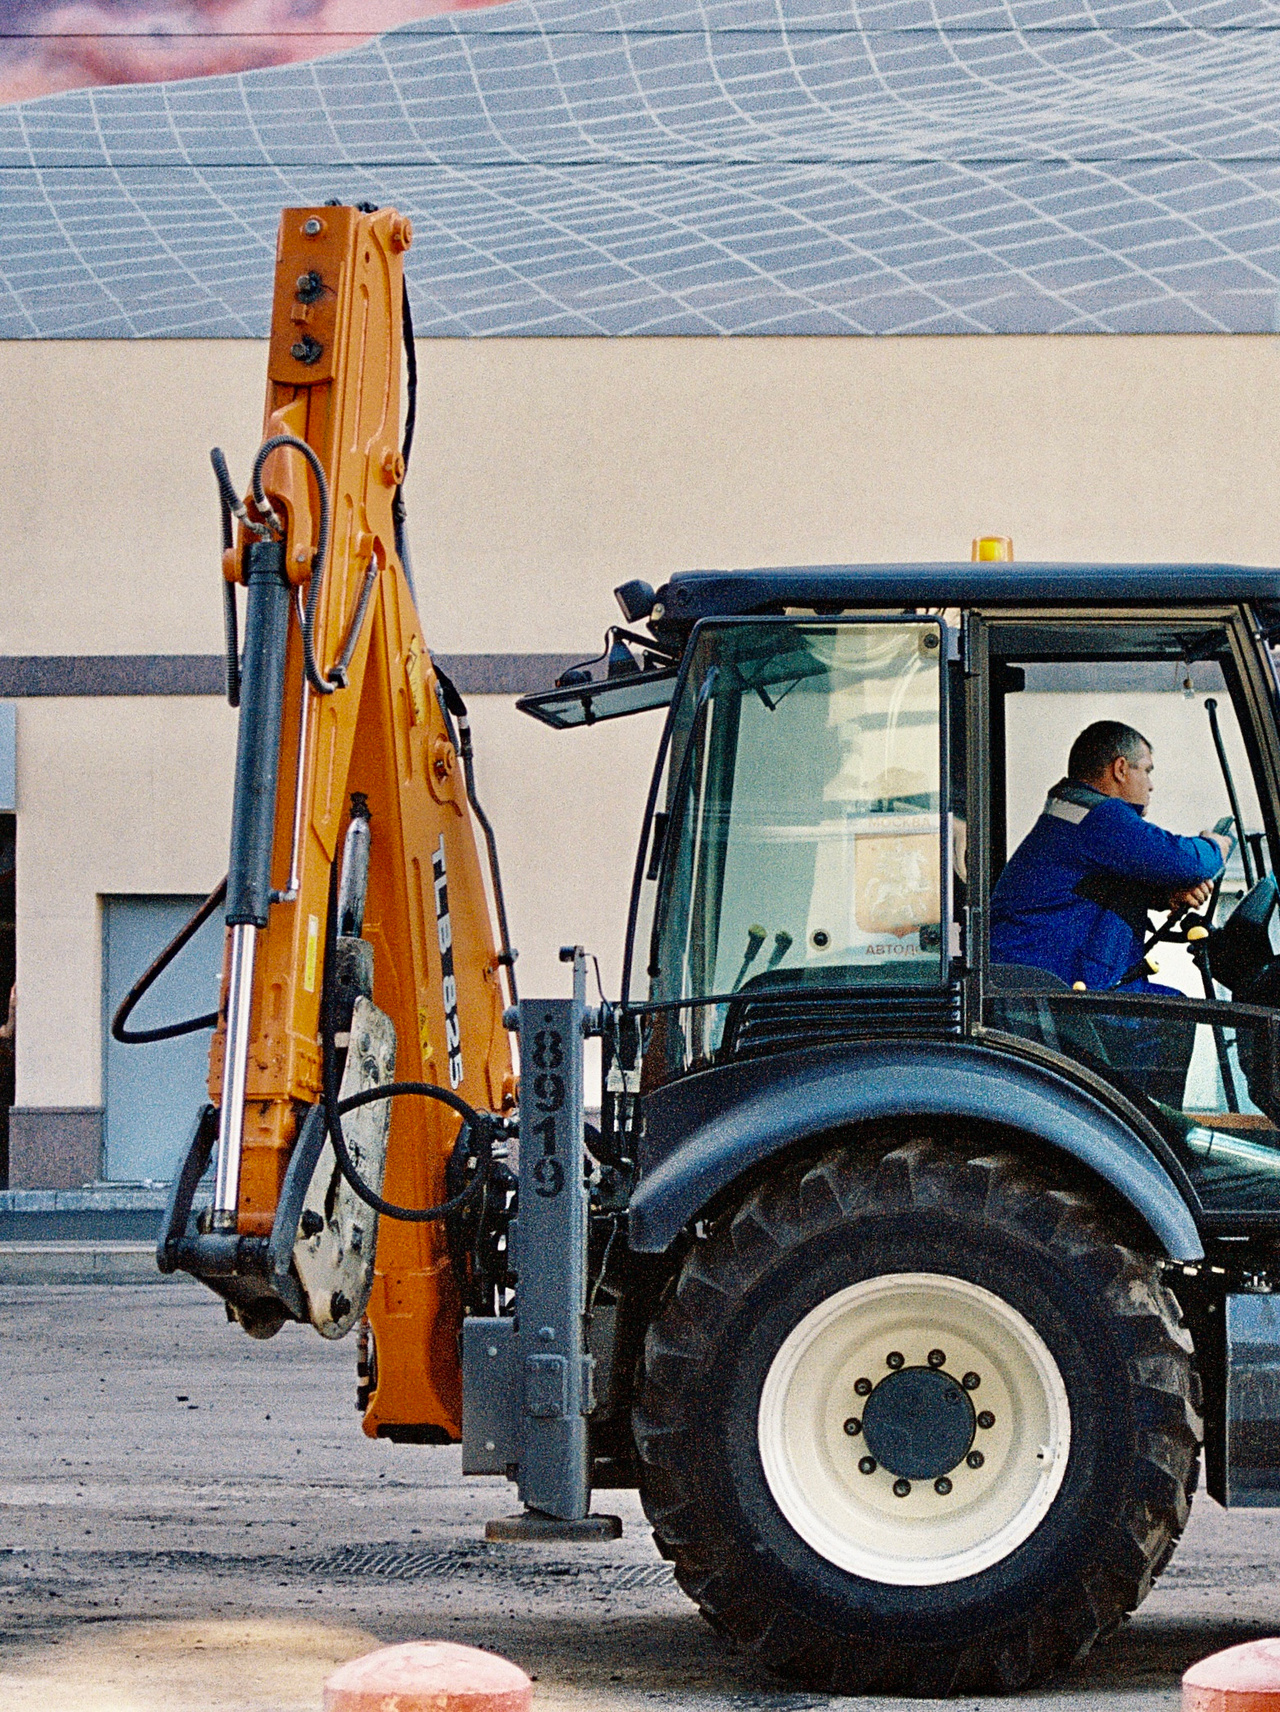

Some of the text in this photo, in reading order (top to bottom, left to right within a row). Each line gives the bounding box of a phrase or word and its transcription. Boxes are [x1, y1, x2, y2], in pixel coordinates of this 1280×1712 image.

[867, 816, 931, 828] МОСКВА
[432, 832, 464, 1091] TLB 825
[533, 1029, 565, 1198] 8919
